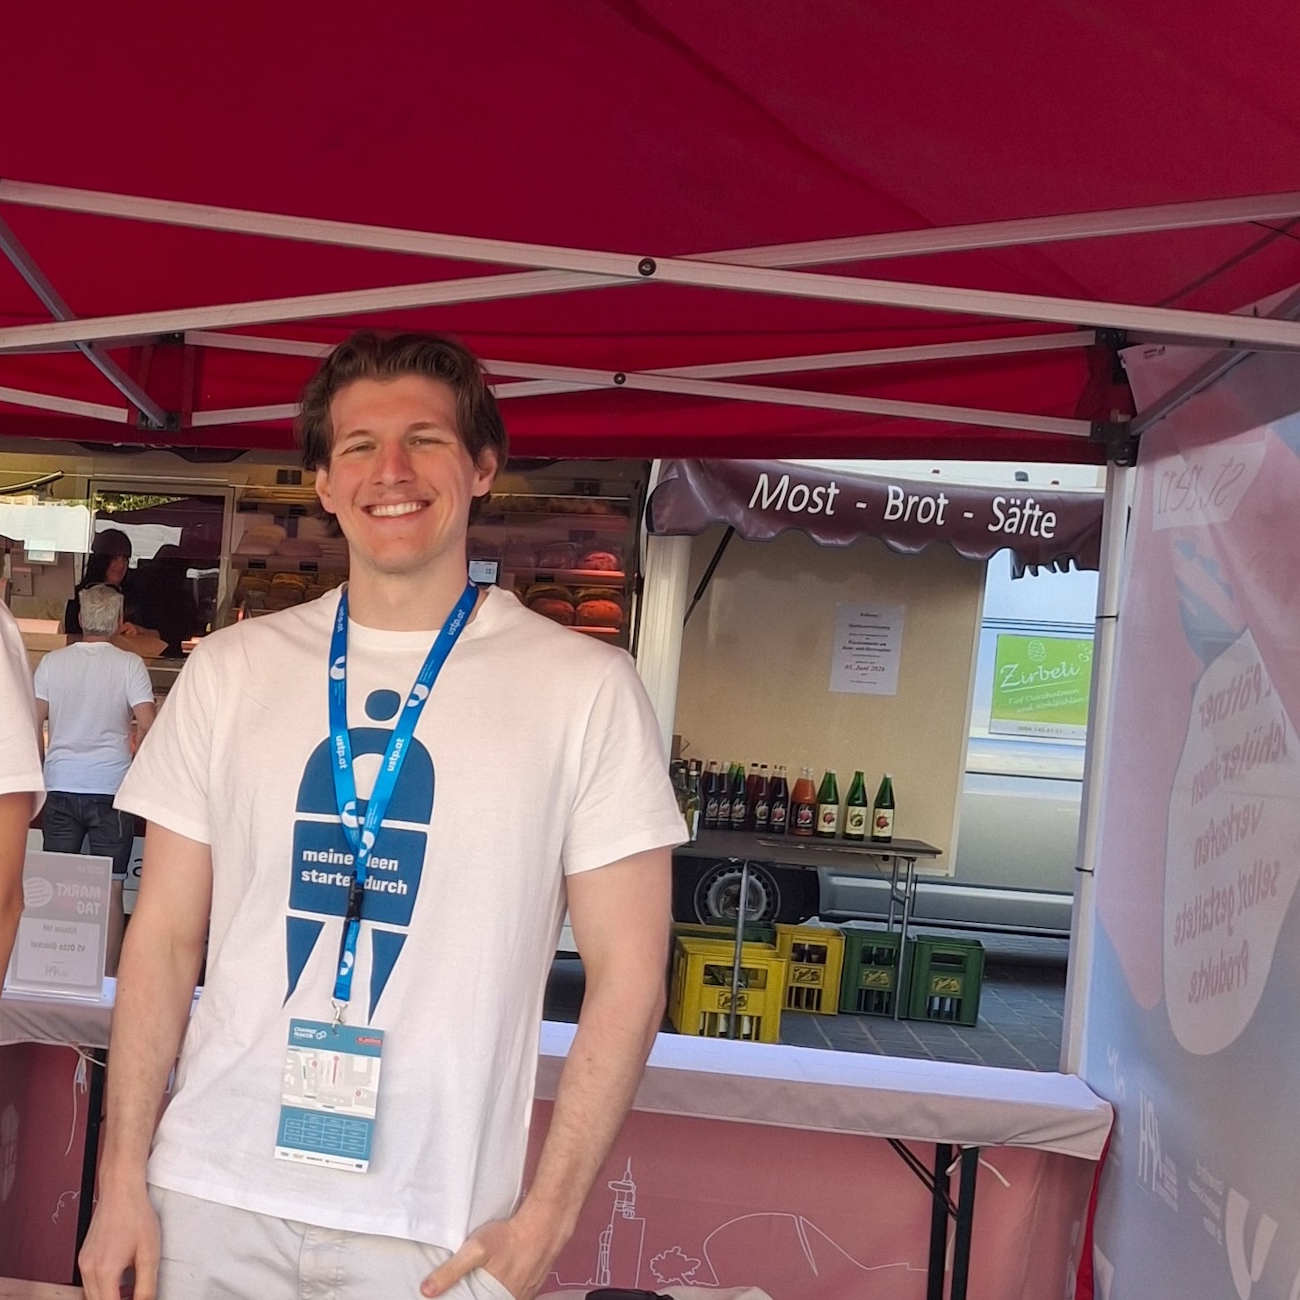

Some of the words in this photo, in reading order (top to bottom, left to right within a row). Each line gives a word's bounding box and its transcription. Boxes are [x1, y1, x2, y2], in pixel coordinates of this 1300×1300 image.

[748, 473, 840, 516] Most
[883, 485, 950, 526] Brot
[987, 496, 1057, 539] Säfte
[447, 609, 466, 637] ustp.at
[1000, 661, 1080, 688] Zirbeli
[335, 735, 348, 771] ustp.at
[387, 737, 405, 773] ustp.at
[303, 848, 354, 866] meine
[364, 876, 408, 896] durch
